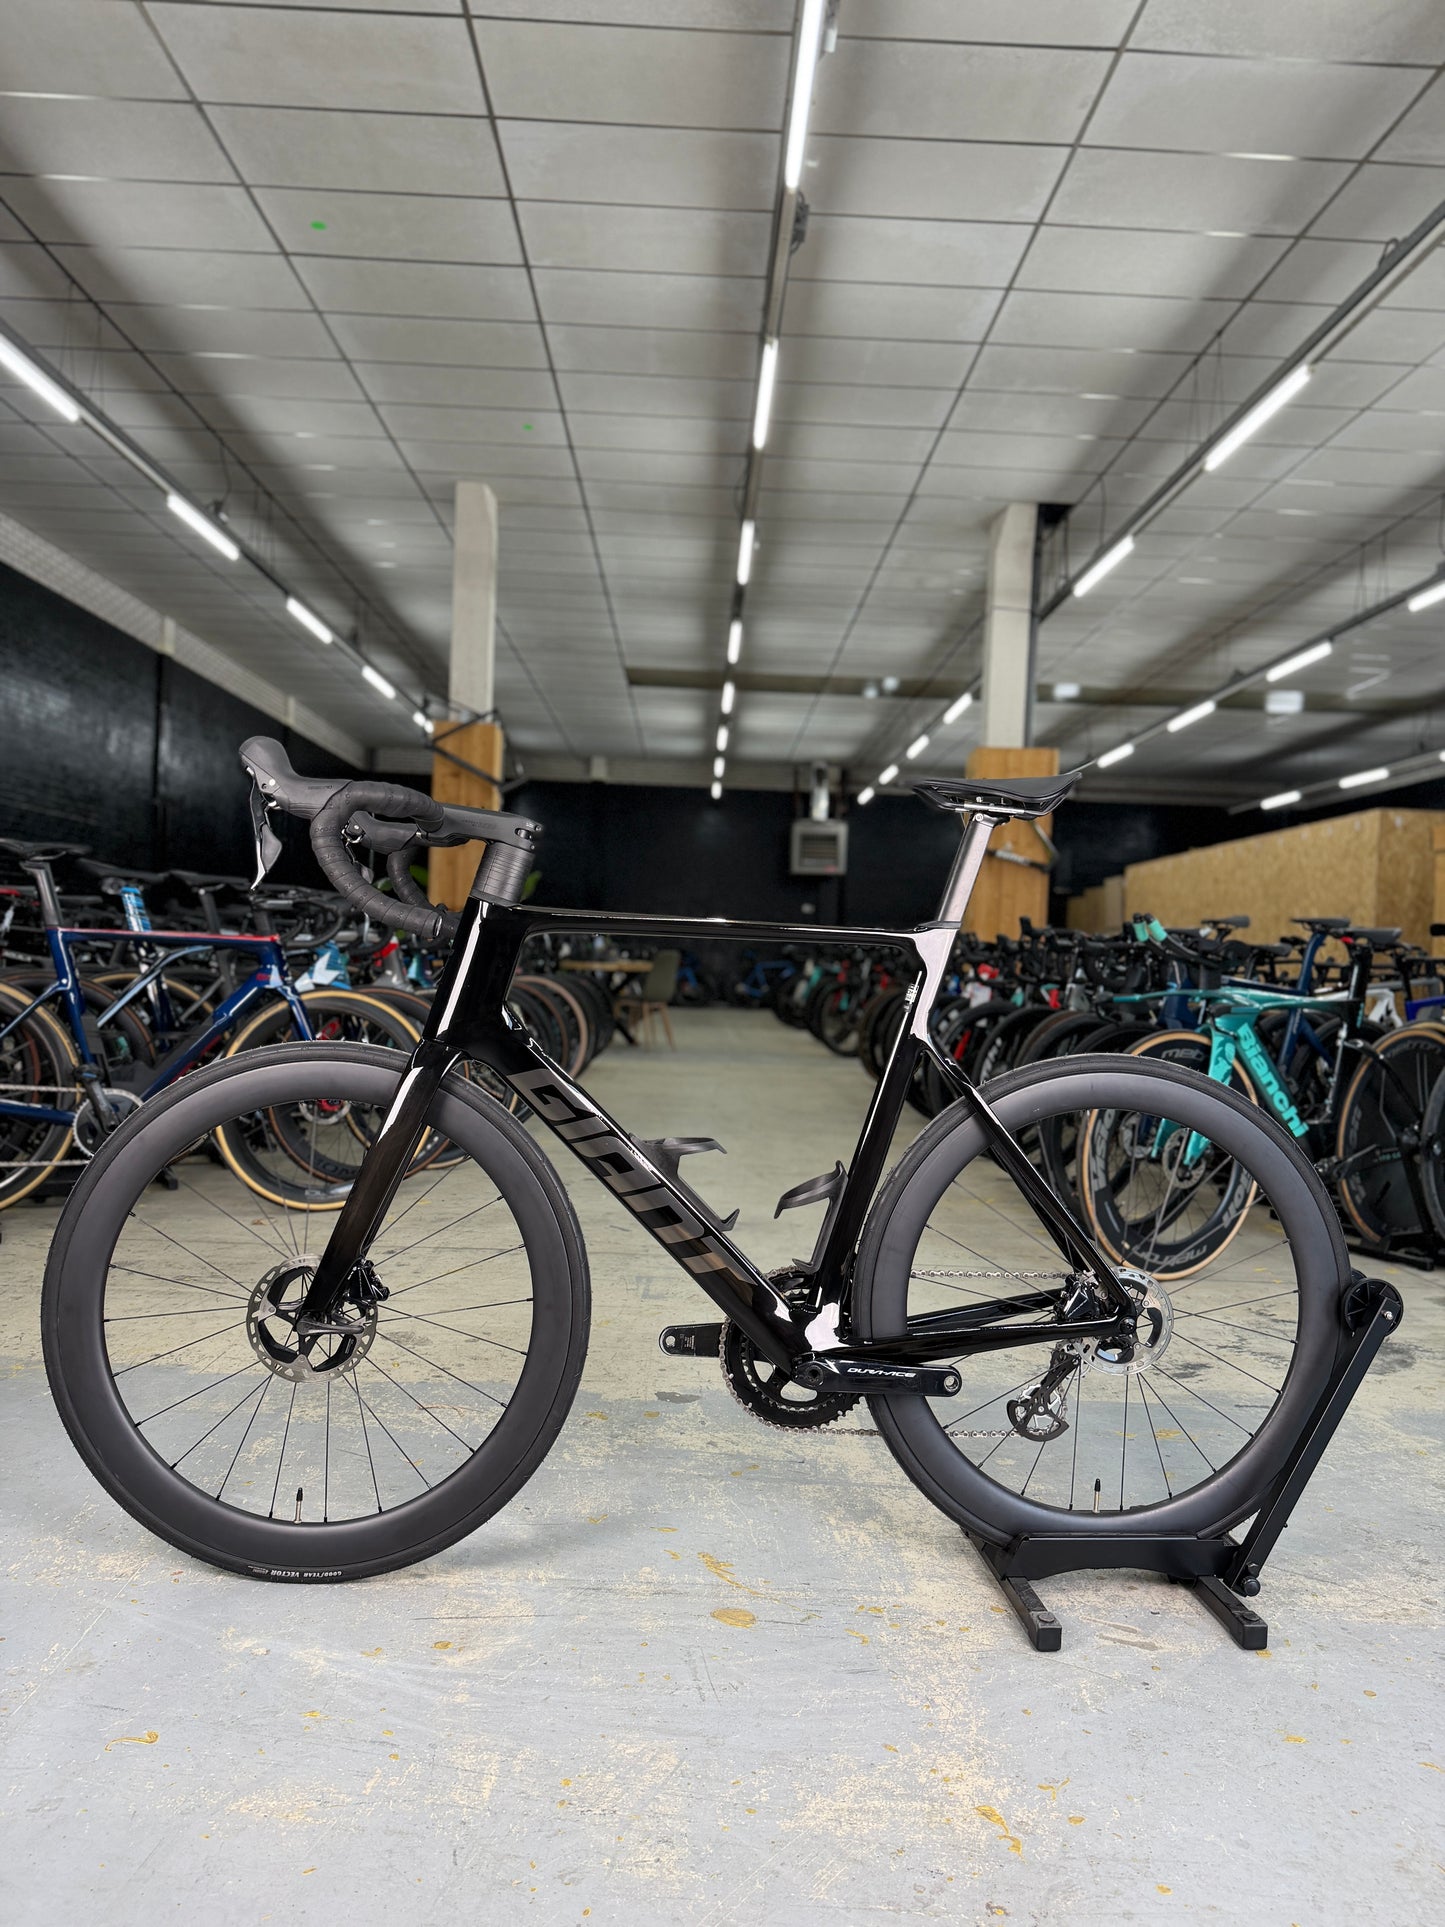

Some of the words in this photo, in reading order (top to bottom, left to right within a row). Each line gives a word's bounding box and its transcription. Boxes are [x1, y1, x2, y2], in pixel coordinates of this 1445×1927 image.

[1237, 1022, 1309, 1138] Bianchi
[507, 1068, 758, 1285] GIANT
[847, 1367, 917, 1378] DURA-ACE
[270, 1569, 300, 1578] VECTOR
